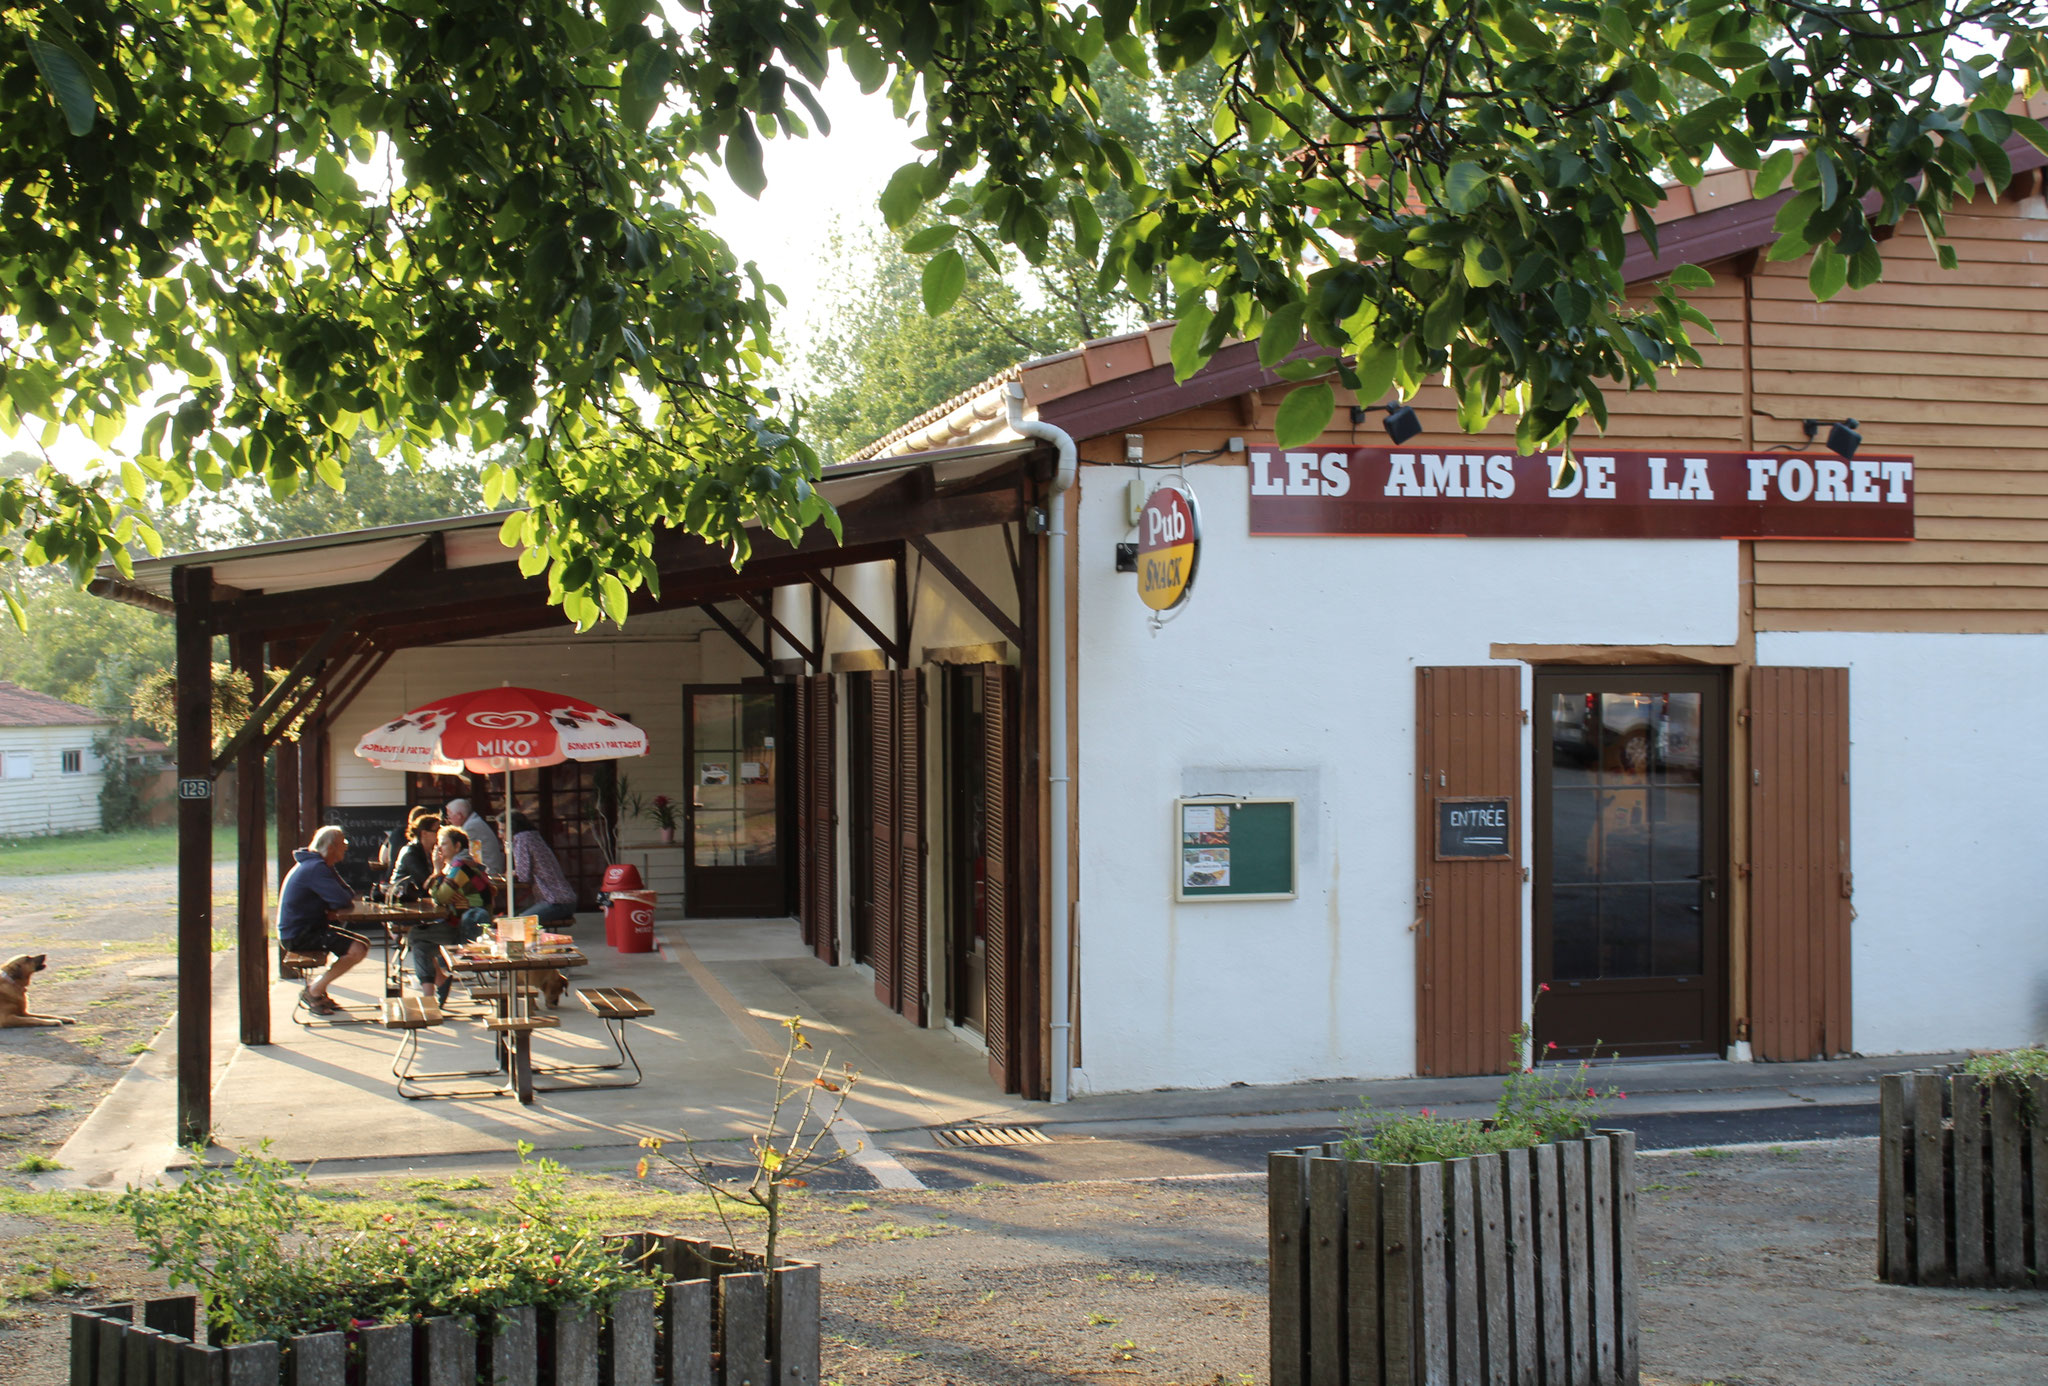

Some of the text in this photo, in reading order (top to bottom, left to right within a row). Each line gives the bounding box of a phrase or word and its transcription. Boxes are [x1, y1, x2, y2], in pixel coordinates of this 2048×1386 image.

[1250, 452, 1913, 503] LES AMIS DE LA FORET
[1147, 500, 1186, 546] Pub
[1145, 557, 1182, 592] SNACK
[477, 739, 531, 756] MIKO
[183, 782, 206, 796] 125
[1450, 804, 1506, 827] ENTRÉE
